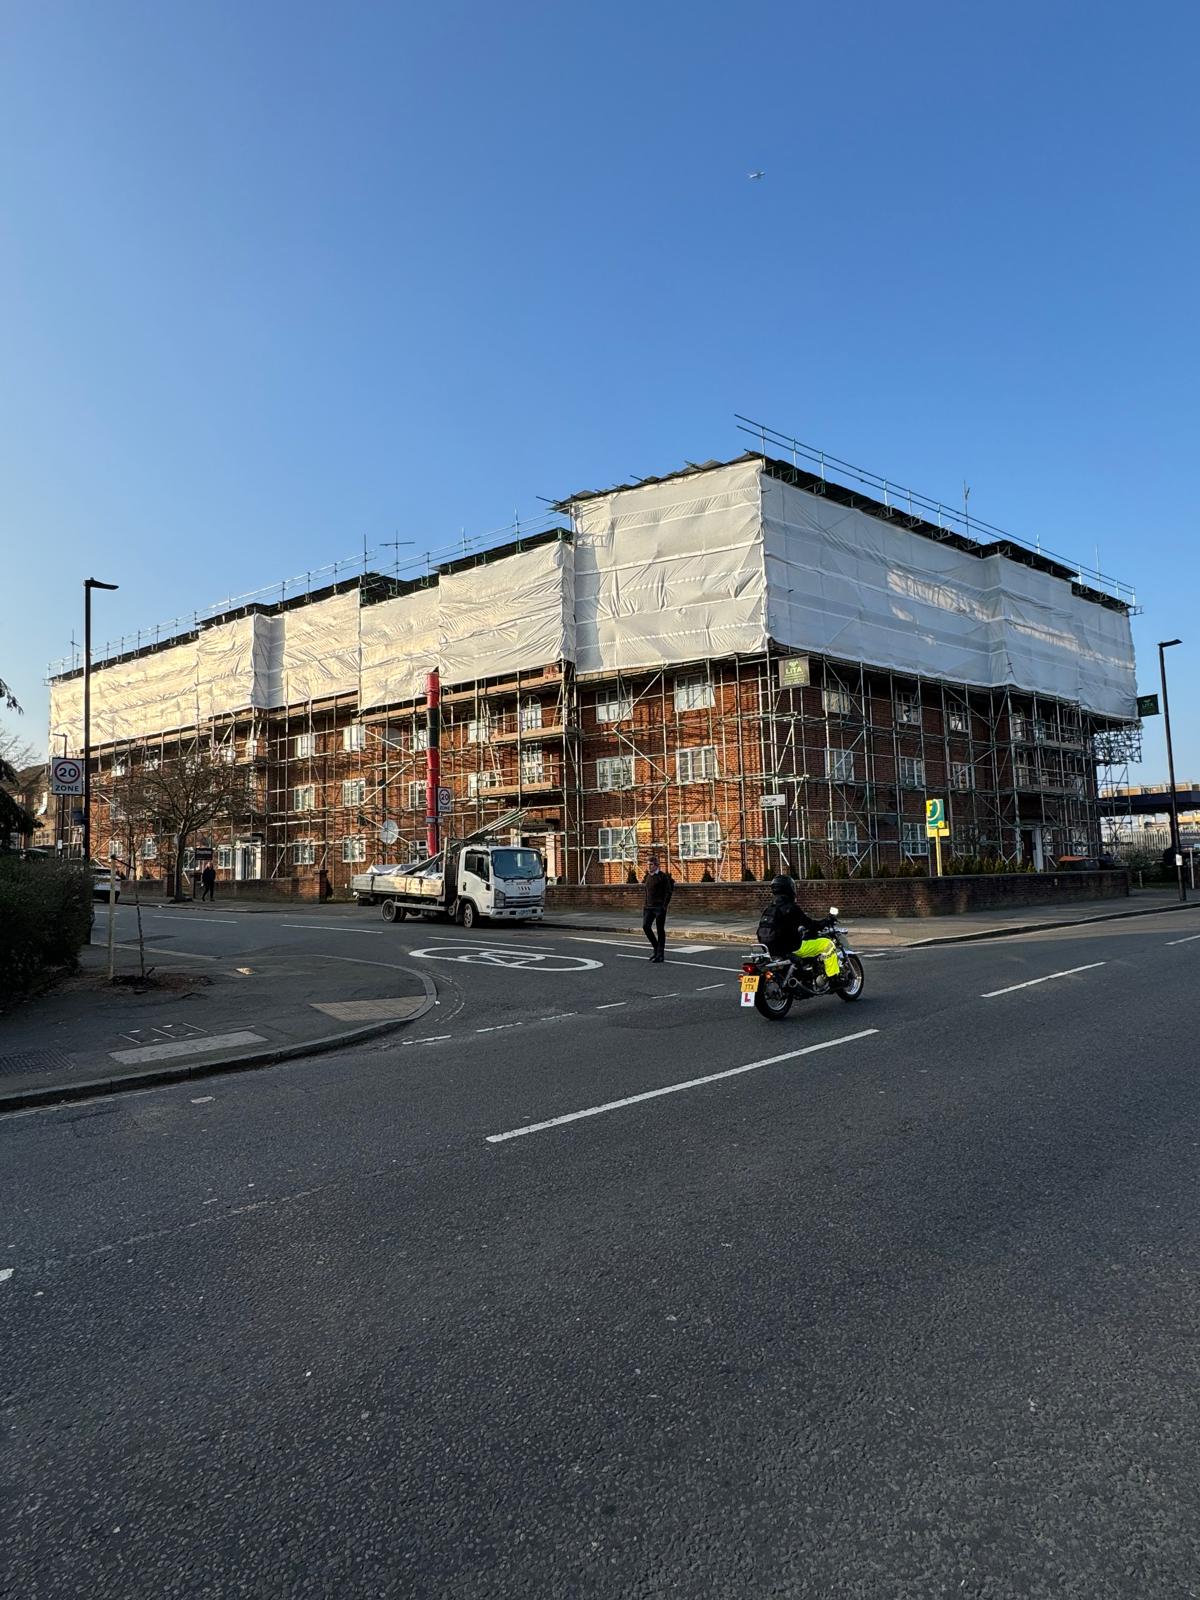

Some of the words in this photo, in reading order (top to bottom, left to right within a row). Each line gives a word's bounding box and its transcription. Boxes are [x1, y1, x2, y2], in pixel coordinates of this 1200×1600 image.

[785, 666, 803, 674] LITA
[58, 767, 77, 778] 20
[439, 793, 449, 801] 20
[744, 992, 751, 1003] L
